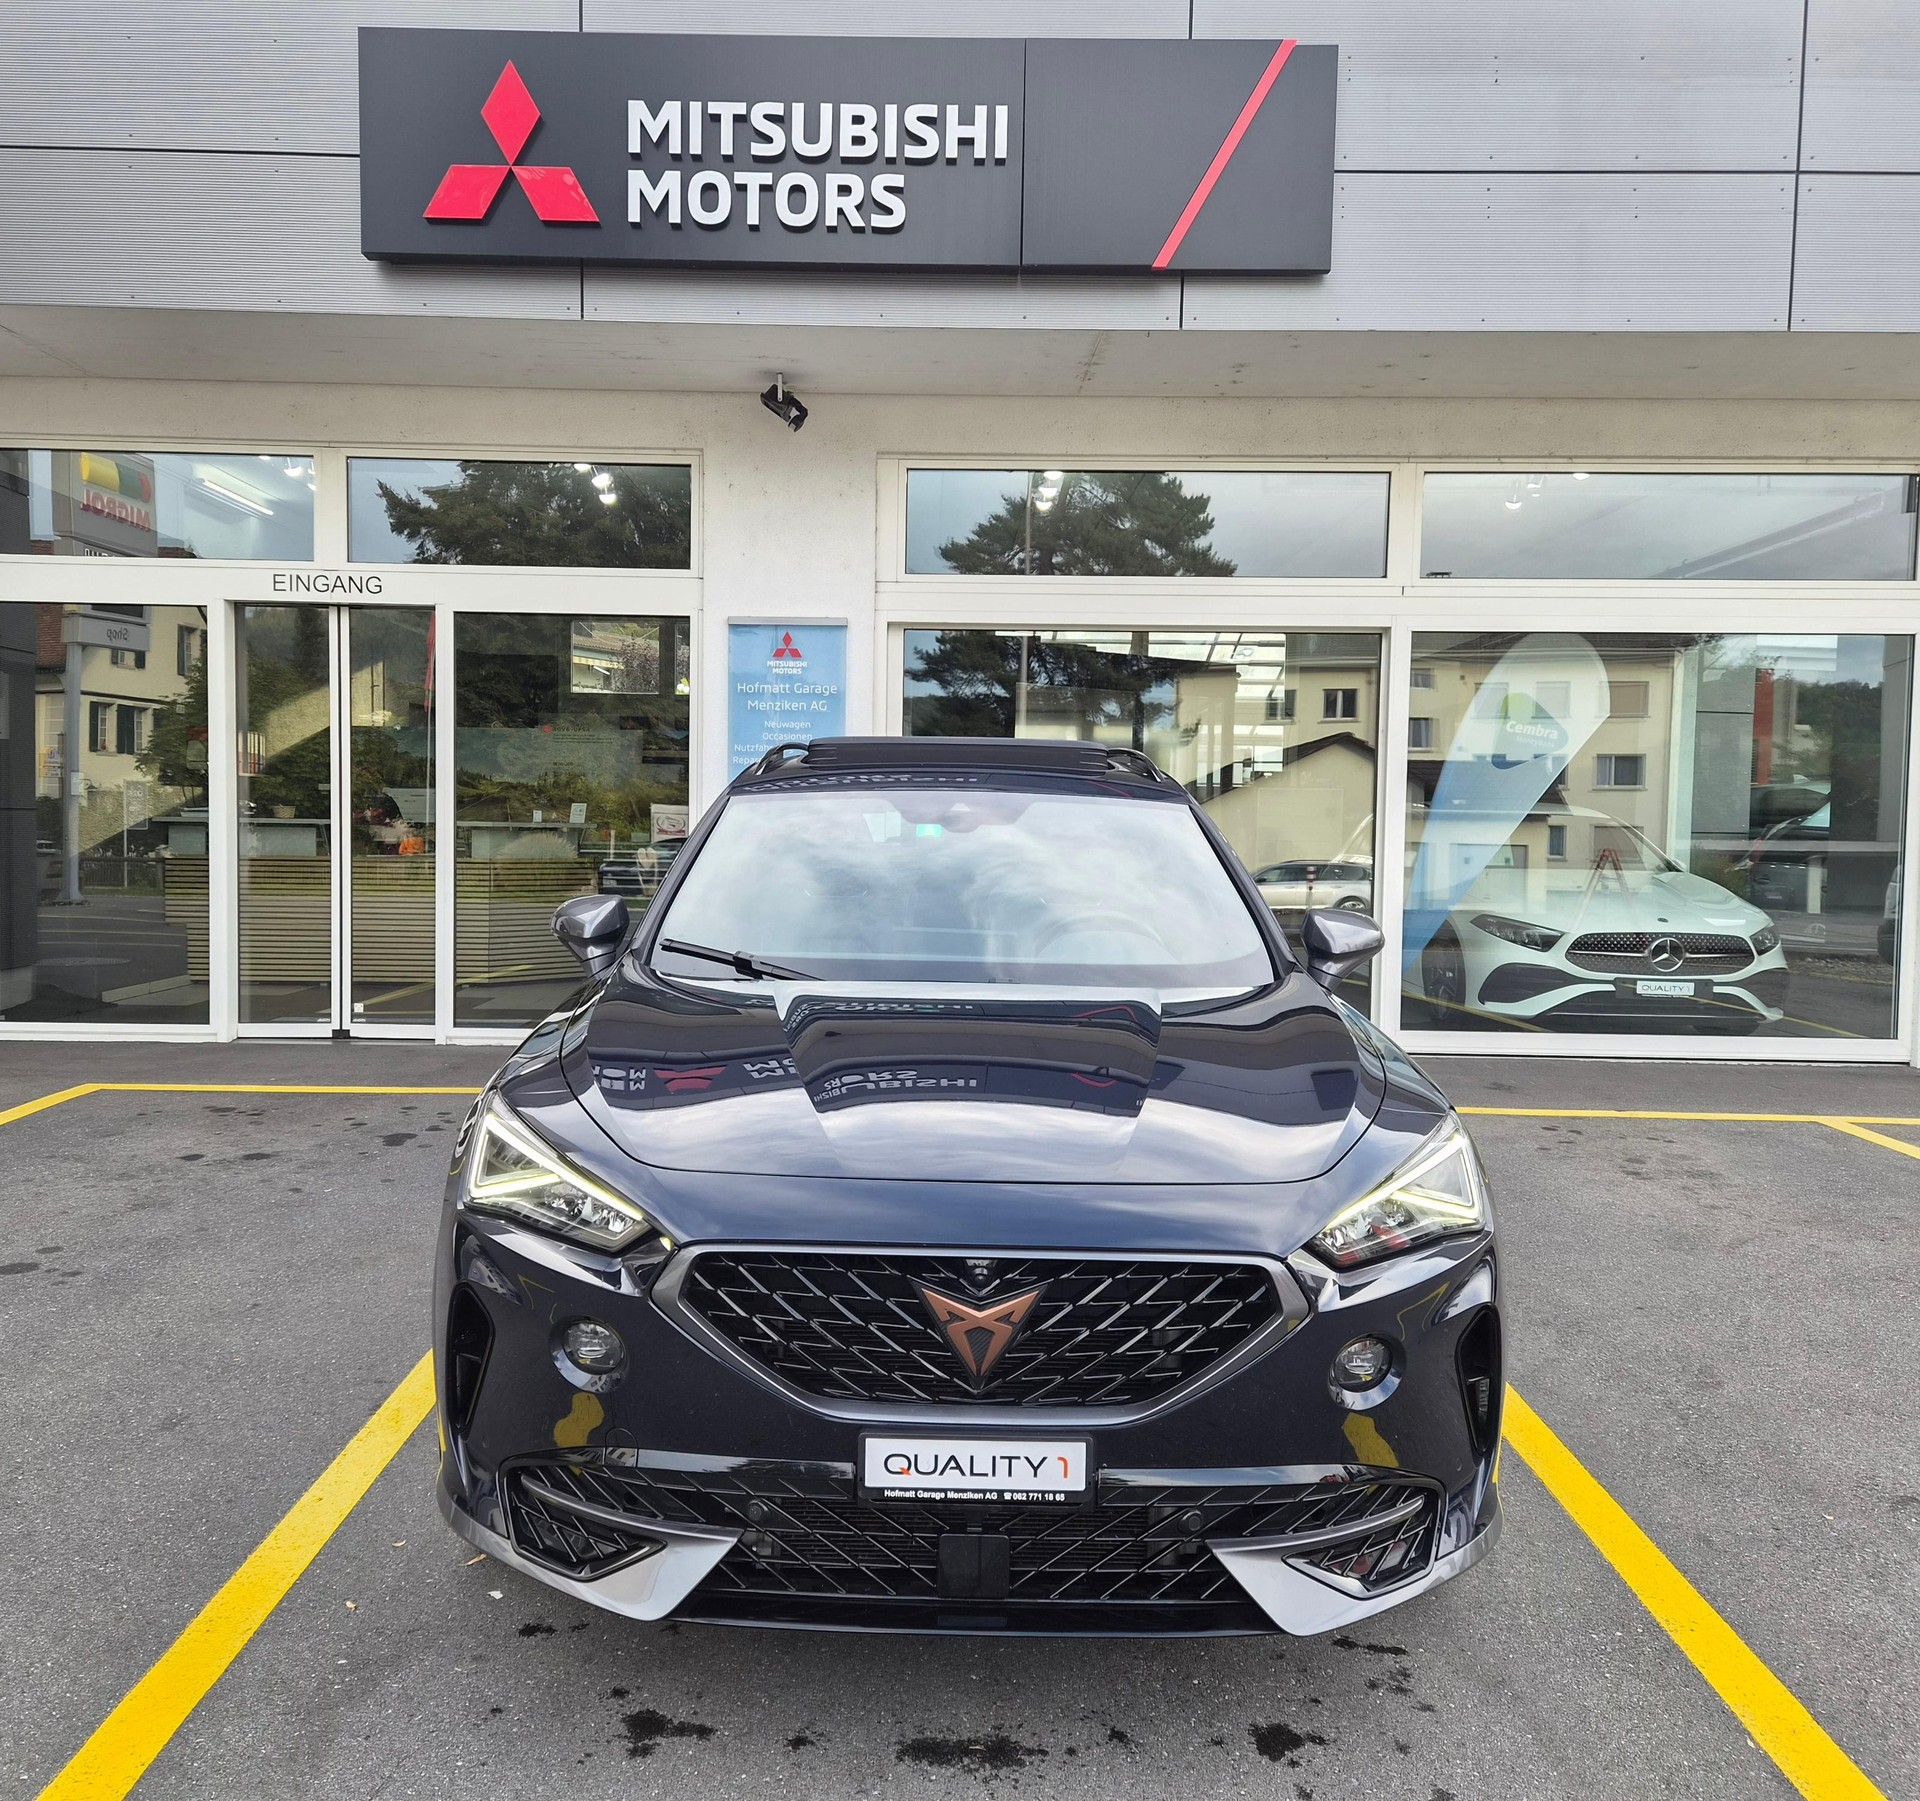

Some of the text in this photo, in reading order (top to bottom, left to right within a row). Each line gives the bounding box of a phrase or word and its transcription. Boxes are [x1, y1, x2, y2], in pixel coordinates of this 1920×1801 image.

[627, 100, 1009, 162] MITSUBISHI
[627, 170, 907, 231] MOTORS
[273, 573, 383, 595] EINGANG
[737, 682, 838, 696] Hofmatt Garage
[747, 699, 828, 711] Menziken AG
[764, 721, 811, 730] Neuwagen
[1505, 721, 1558, 740] Cembra
[762, 732, 813, 741] Occasionen
[1641, 984, 1684, 992] QUALITY
[883, 1453, 1069, 1479] QUALITY 1
[884, 1489, 1066, 1502] Hofmatt Garage Menziken AG 062 771 18 65
